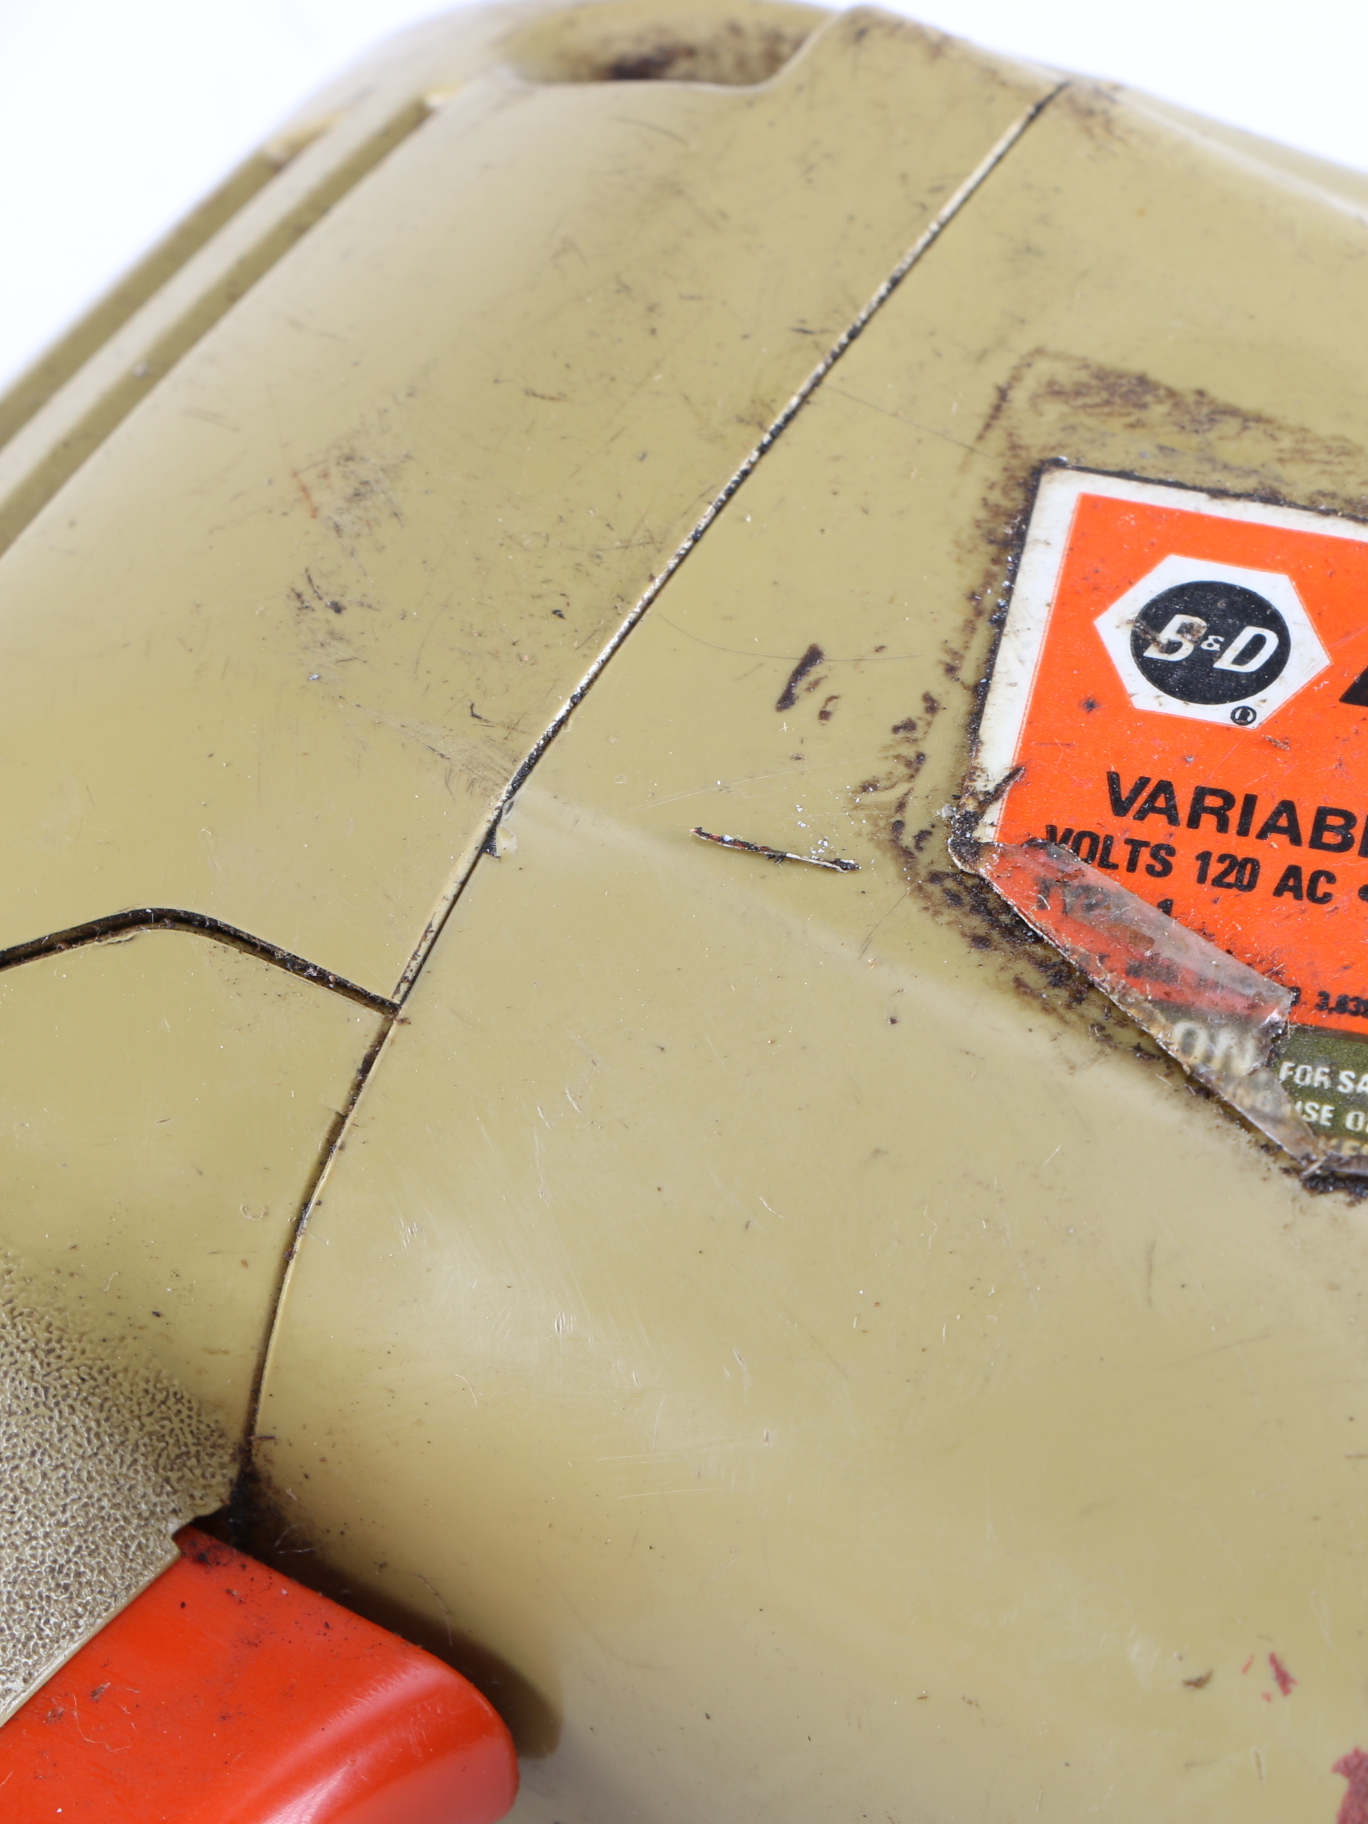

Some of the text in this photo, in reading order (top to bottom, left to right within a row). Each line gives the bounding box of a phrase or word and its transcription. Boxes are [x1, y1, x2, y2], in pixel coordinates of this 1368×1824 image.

[1195, 850, 1261, 893] 120
[1272, 869, 1337, 905] AC
[1279, 1061, 1332, 1089] FOR
